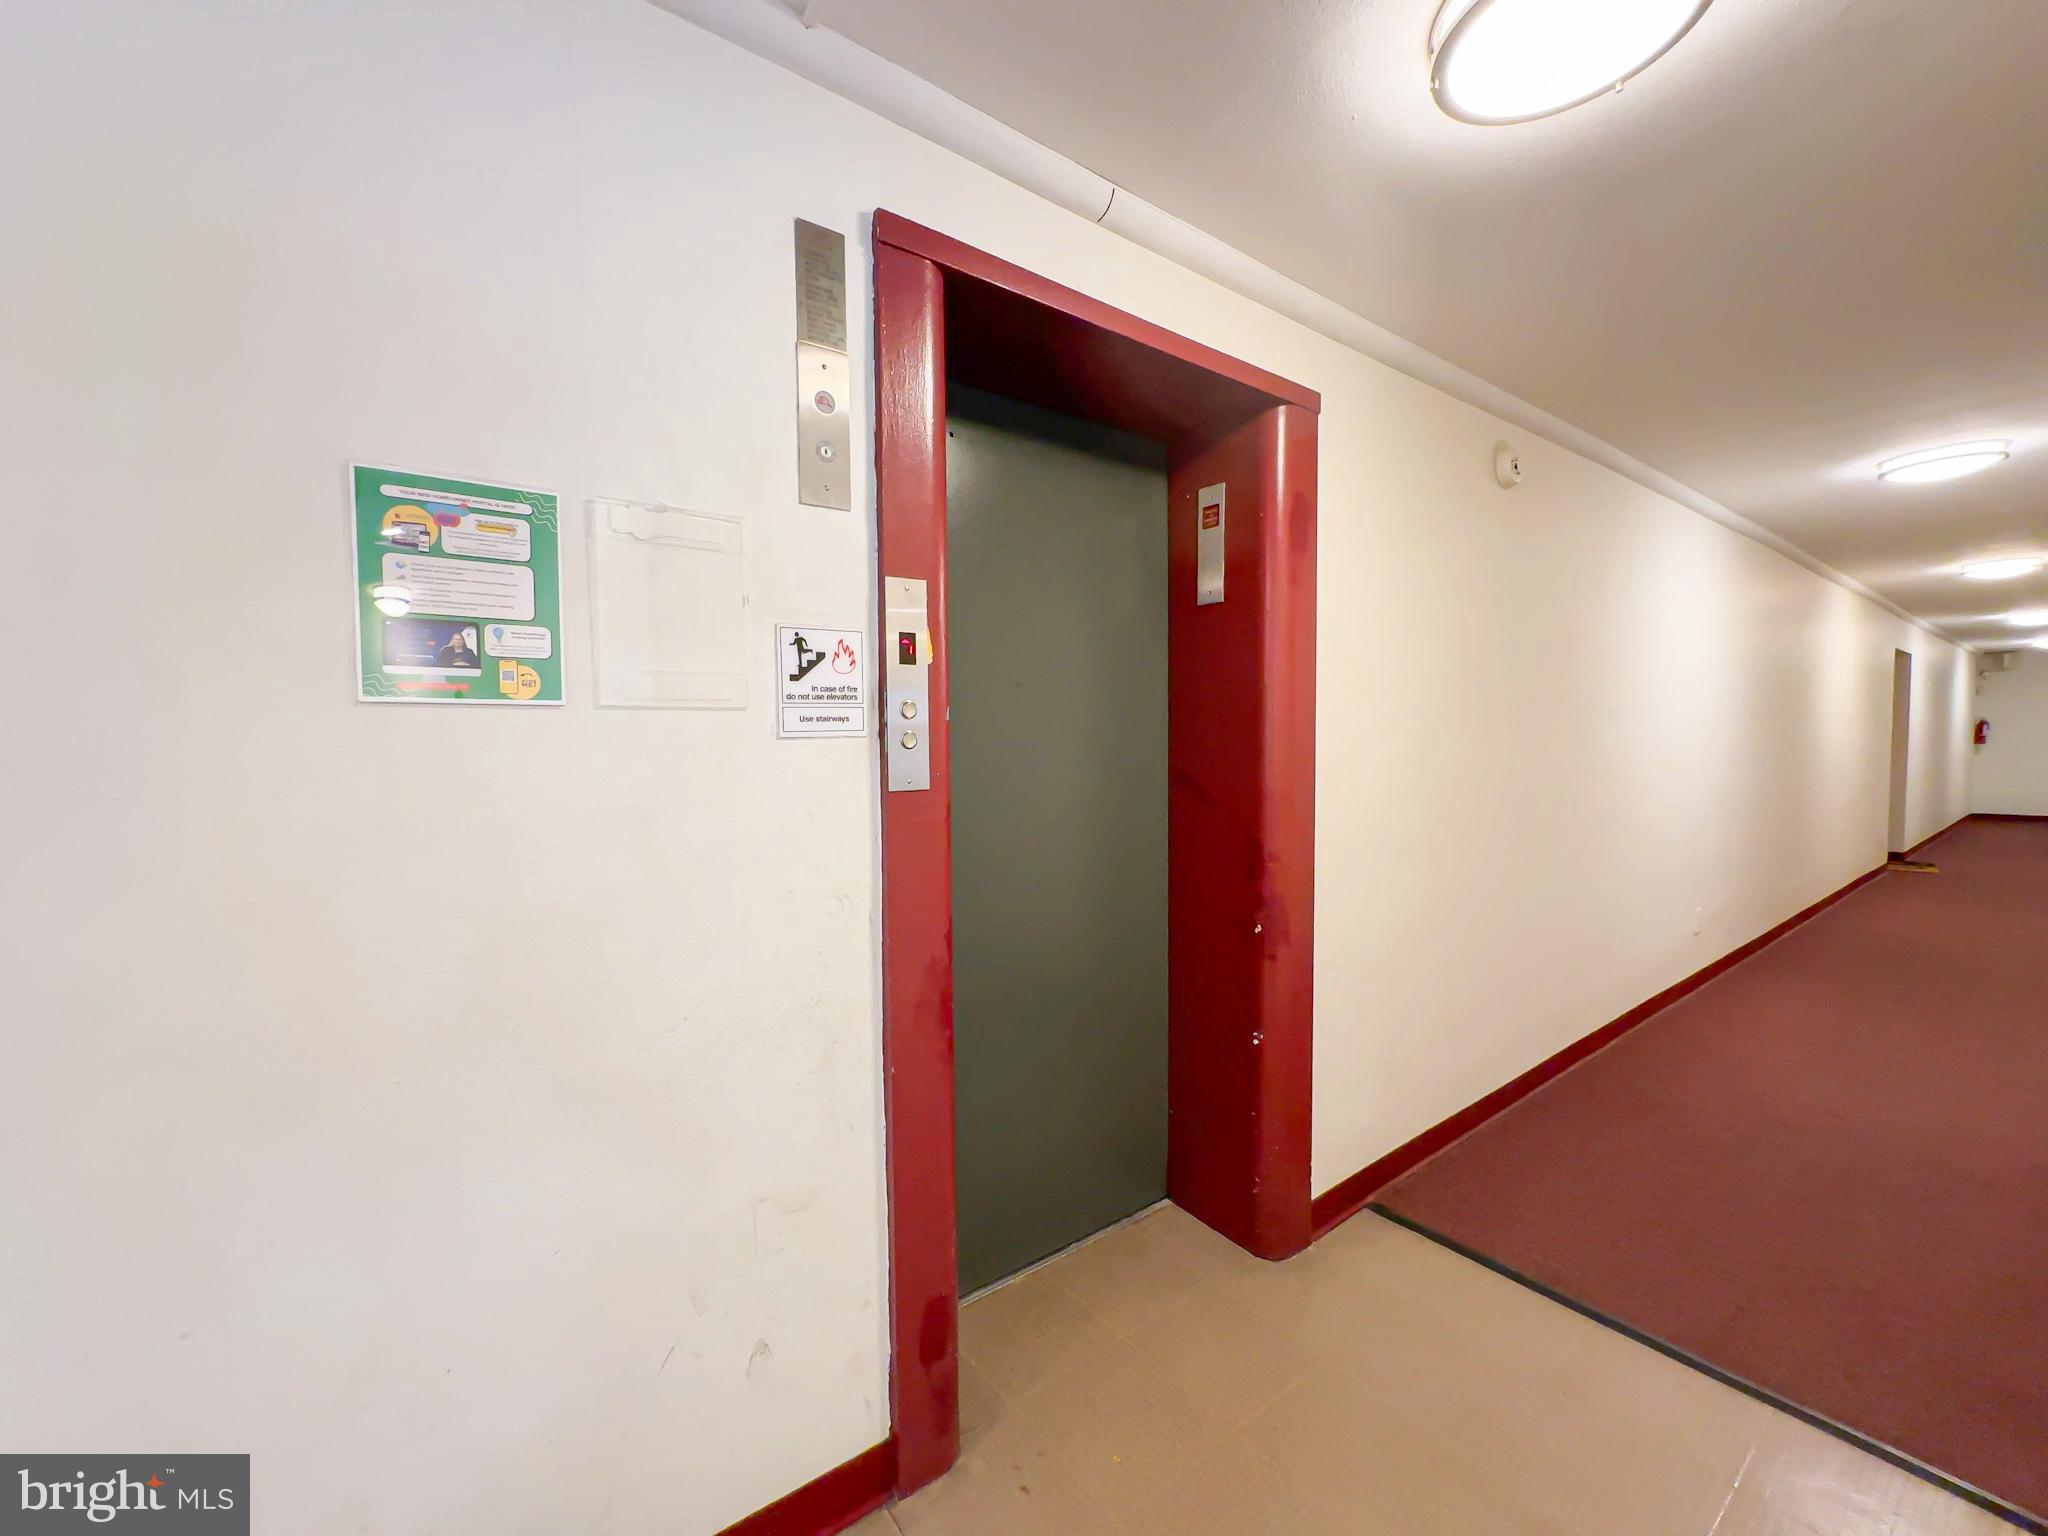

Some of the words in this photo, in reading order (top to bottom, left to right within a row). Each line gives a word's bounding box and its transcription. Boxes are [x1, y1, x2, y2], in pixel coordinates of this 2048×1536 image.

[838, 685, 846, 693] of
[846, 685, 858, 693] fire
[826, 693, 858, 701] elevators
[799, 715, 814, 723] Use
[815, 715, 850, 724] stairways
